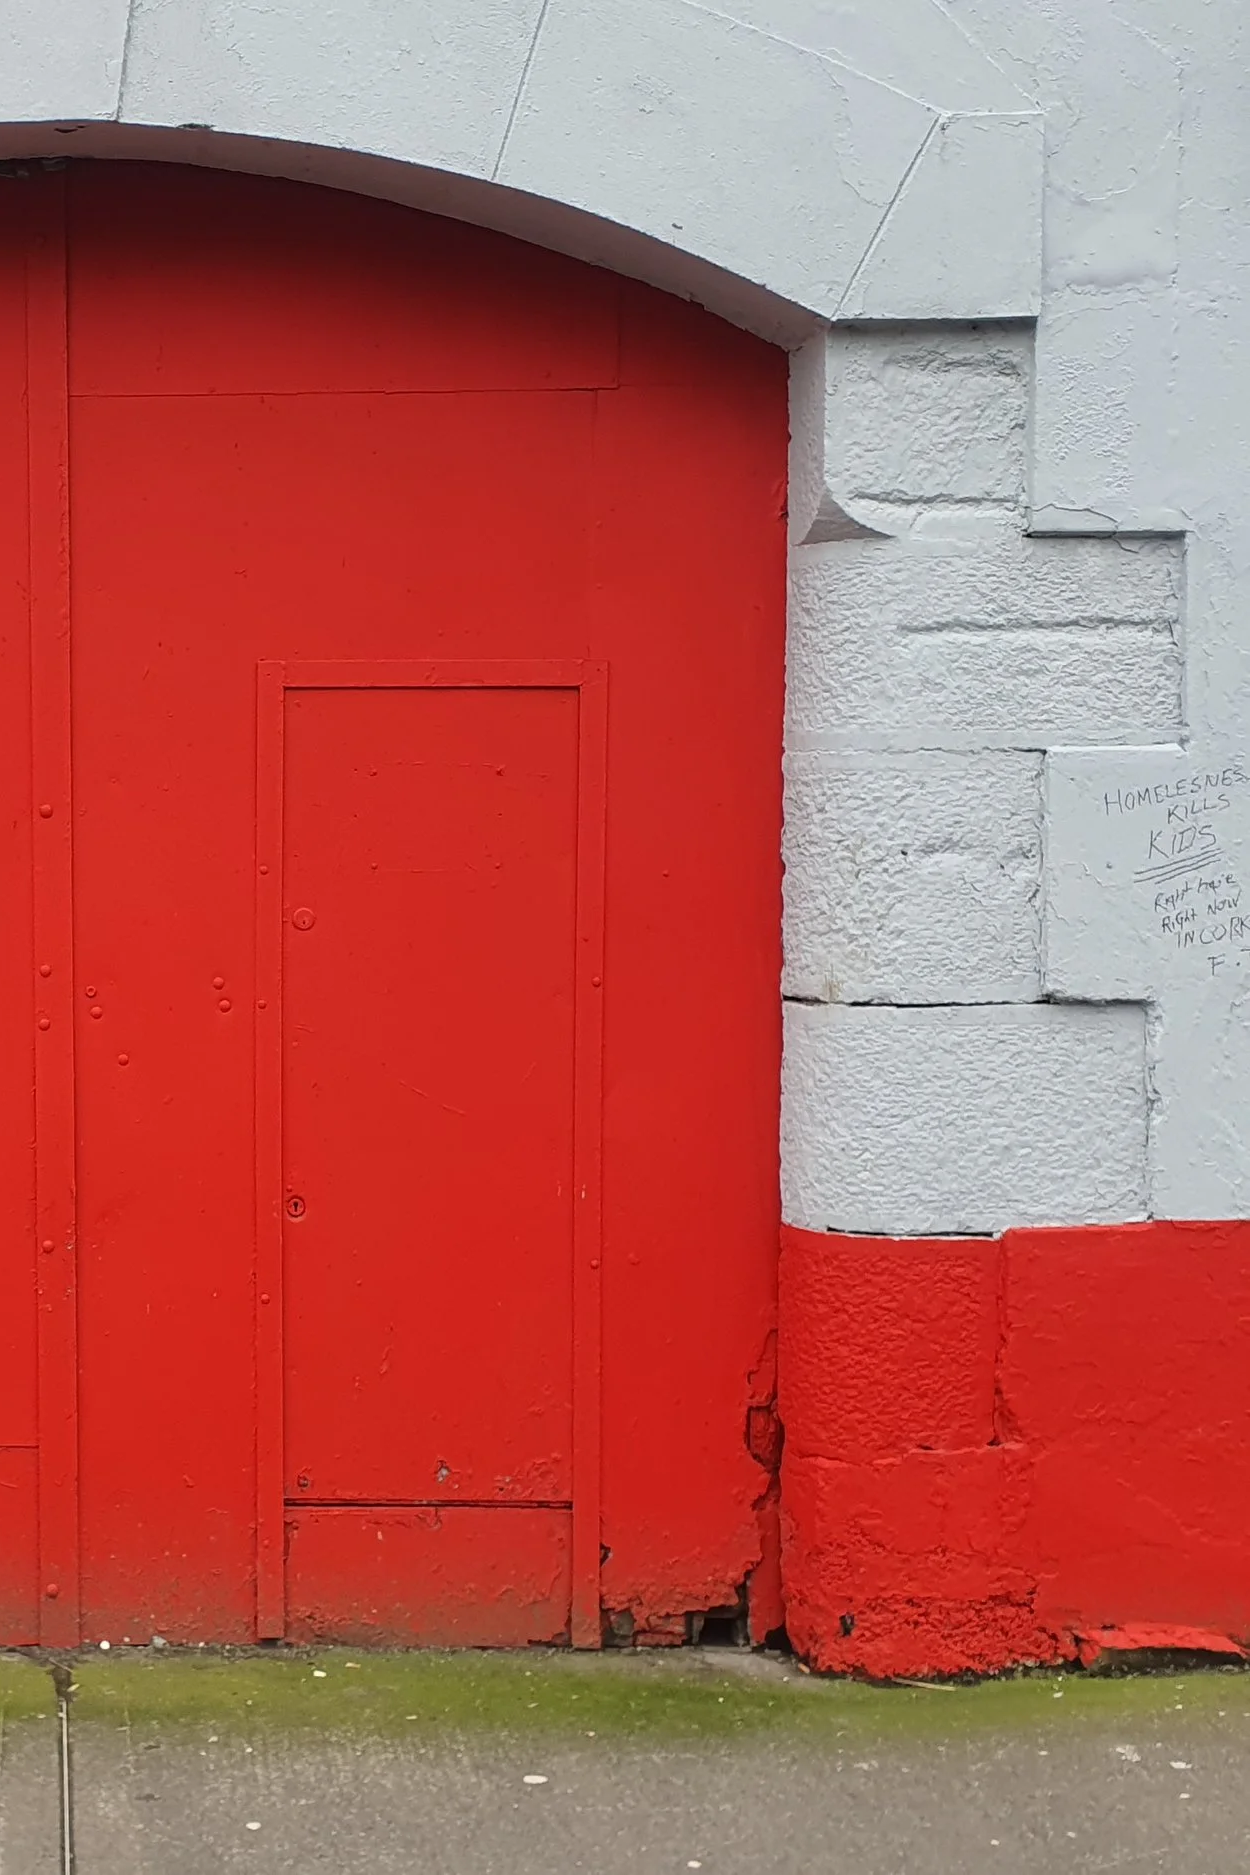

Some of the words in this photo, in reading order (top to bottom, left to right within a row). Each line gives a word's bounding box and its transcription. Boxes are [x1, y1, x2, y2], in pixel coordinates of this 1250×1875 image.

[1167, 793, 1230, 824] KILLS
[1148, 825, 1217, 860] KIDS
[1175, 930, 1195, 948] IN
